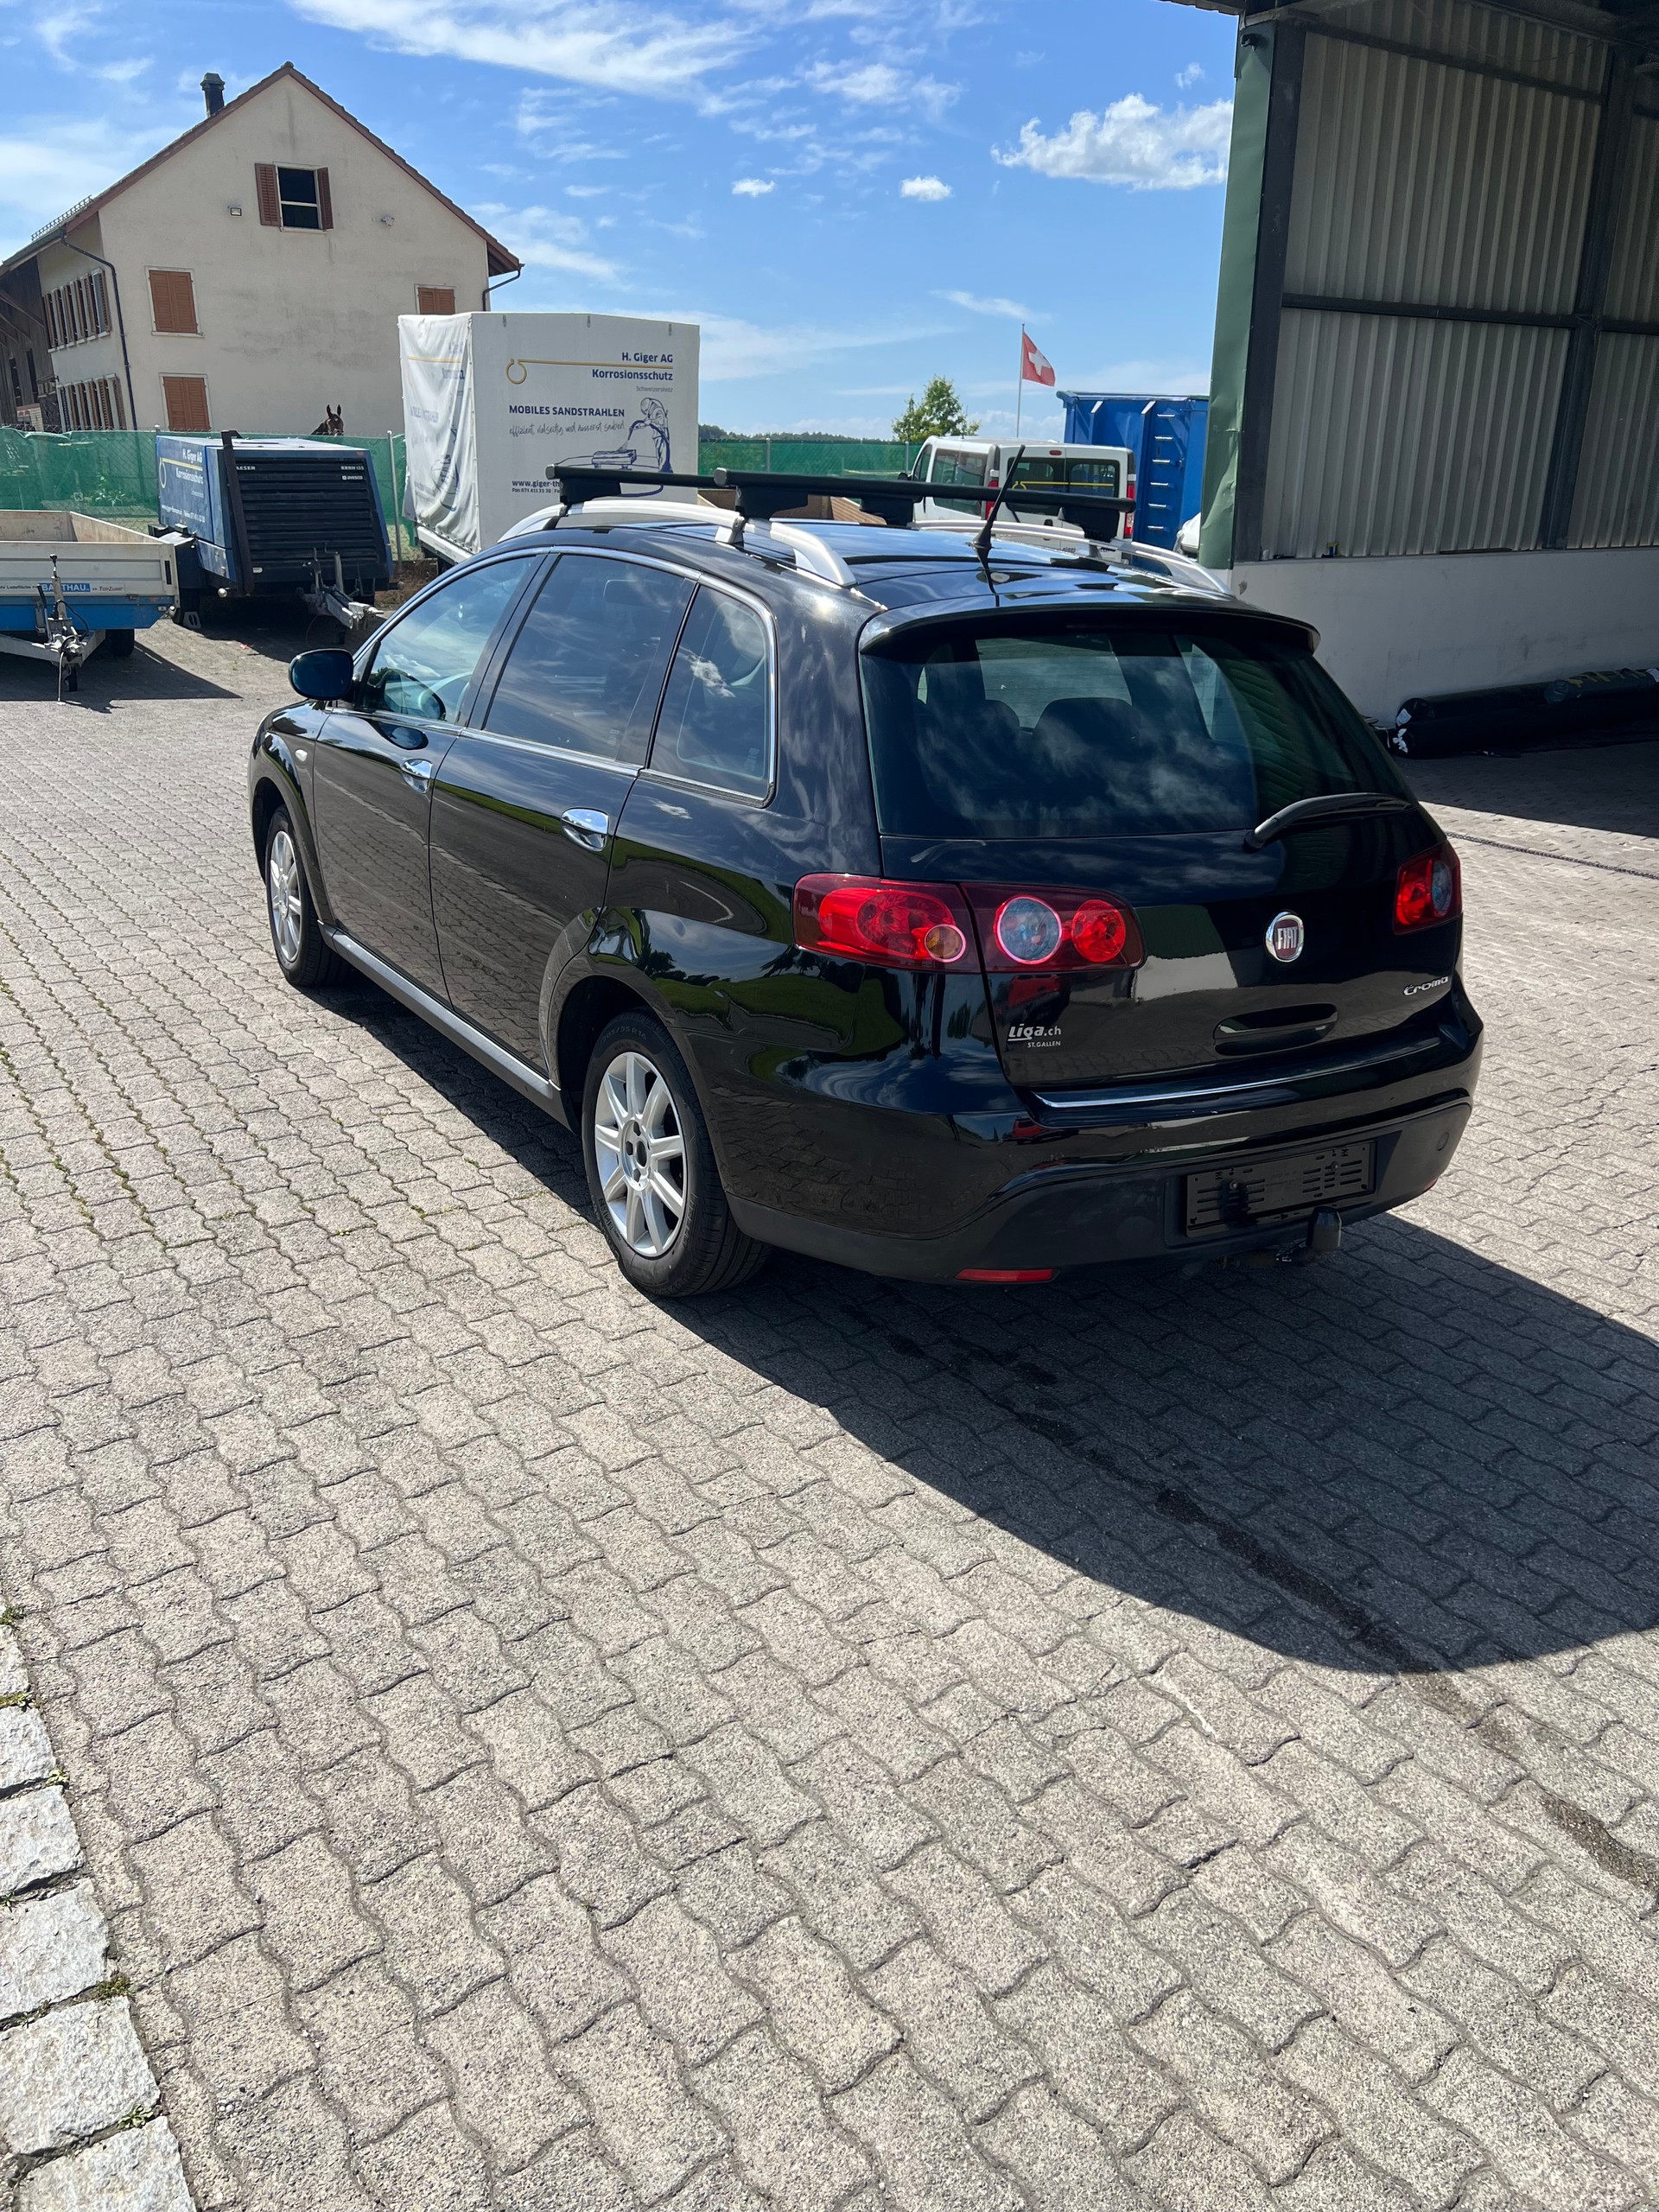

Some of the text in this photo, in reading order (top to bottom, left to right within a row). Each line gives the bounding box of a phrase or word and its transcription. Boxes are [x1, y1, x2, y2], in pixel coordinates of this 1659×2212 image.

[621, 353, 673, 364] H. Giger AG
[592, 369, 673, 381] Korrosionsschutz
[509, 405, 625, 416] MOBILES SANDSTRAHLEN
[1277, 926, 1298, 950] FIAT
[1403, 976, 1449, 996] Croma
[1007, 1023, 1062, 1041] Liga.ch
